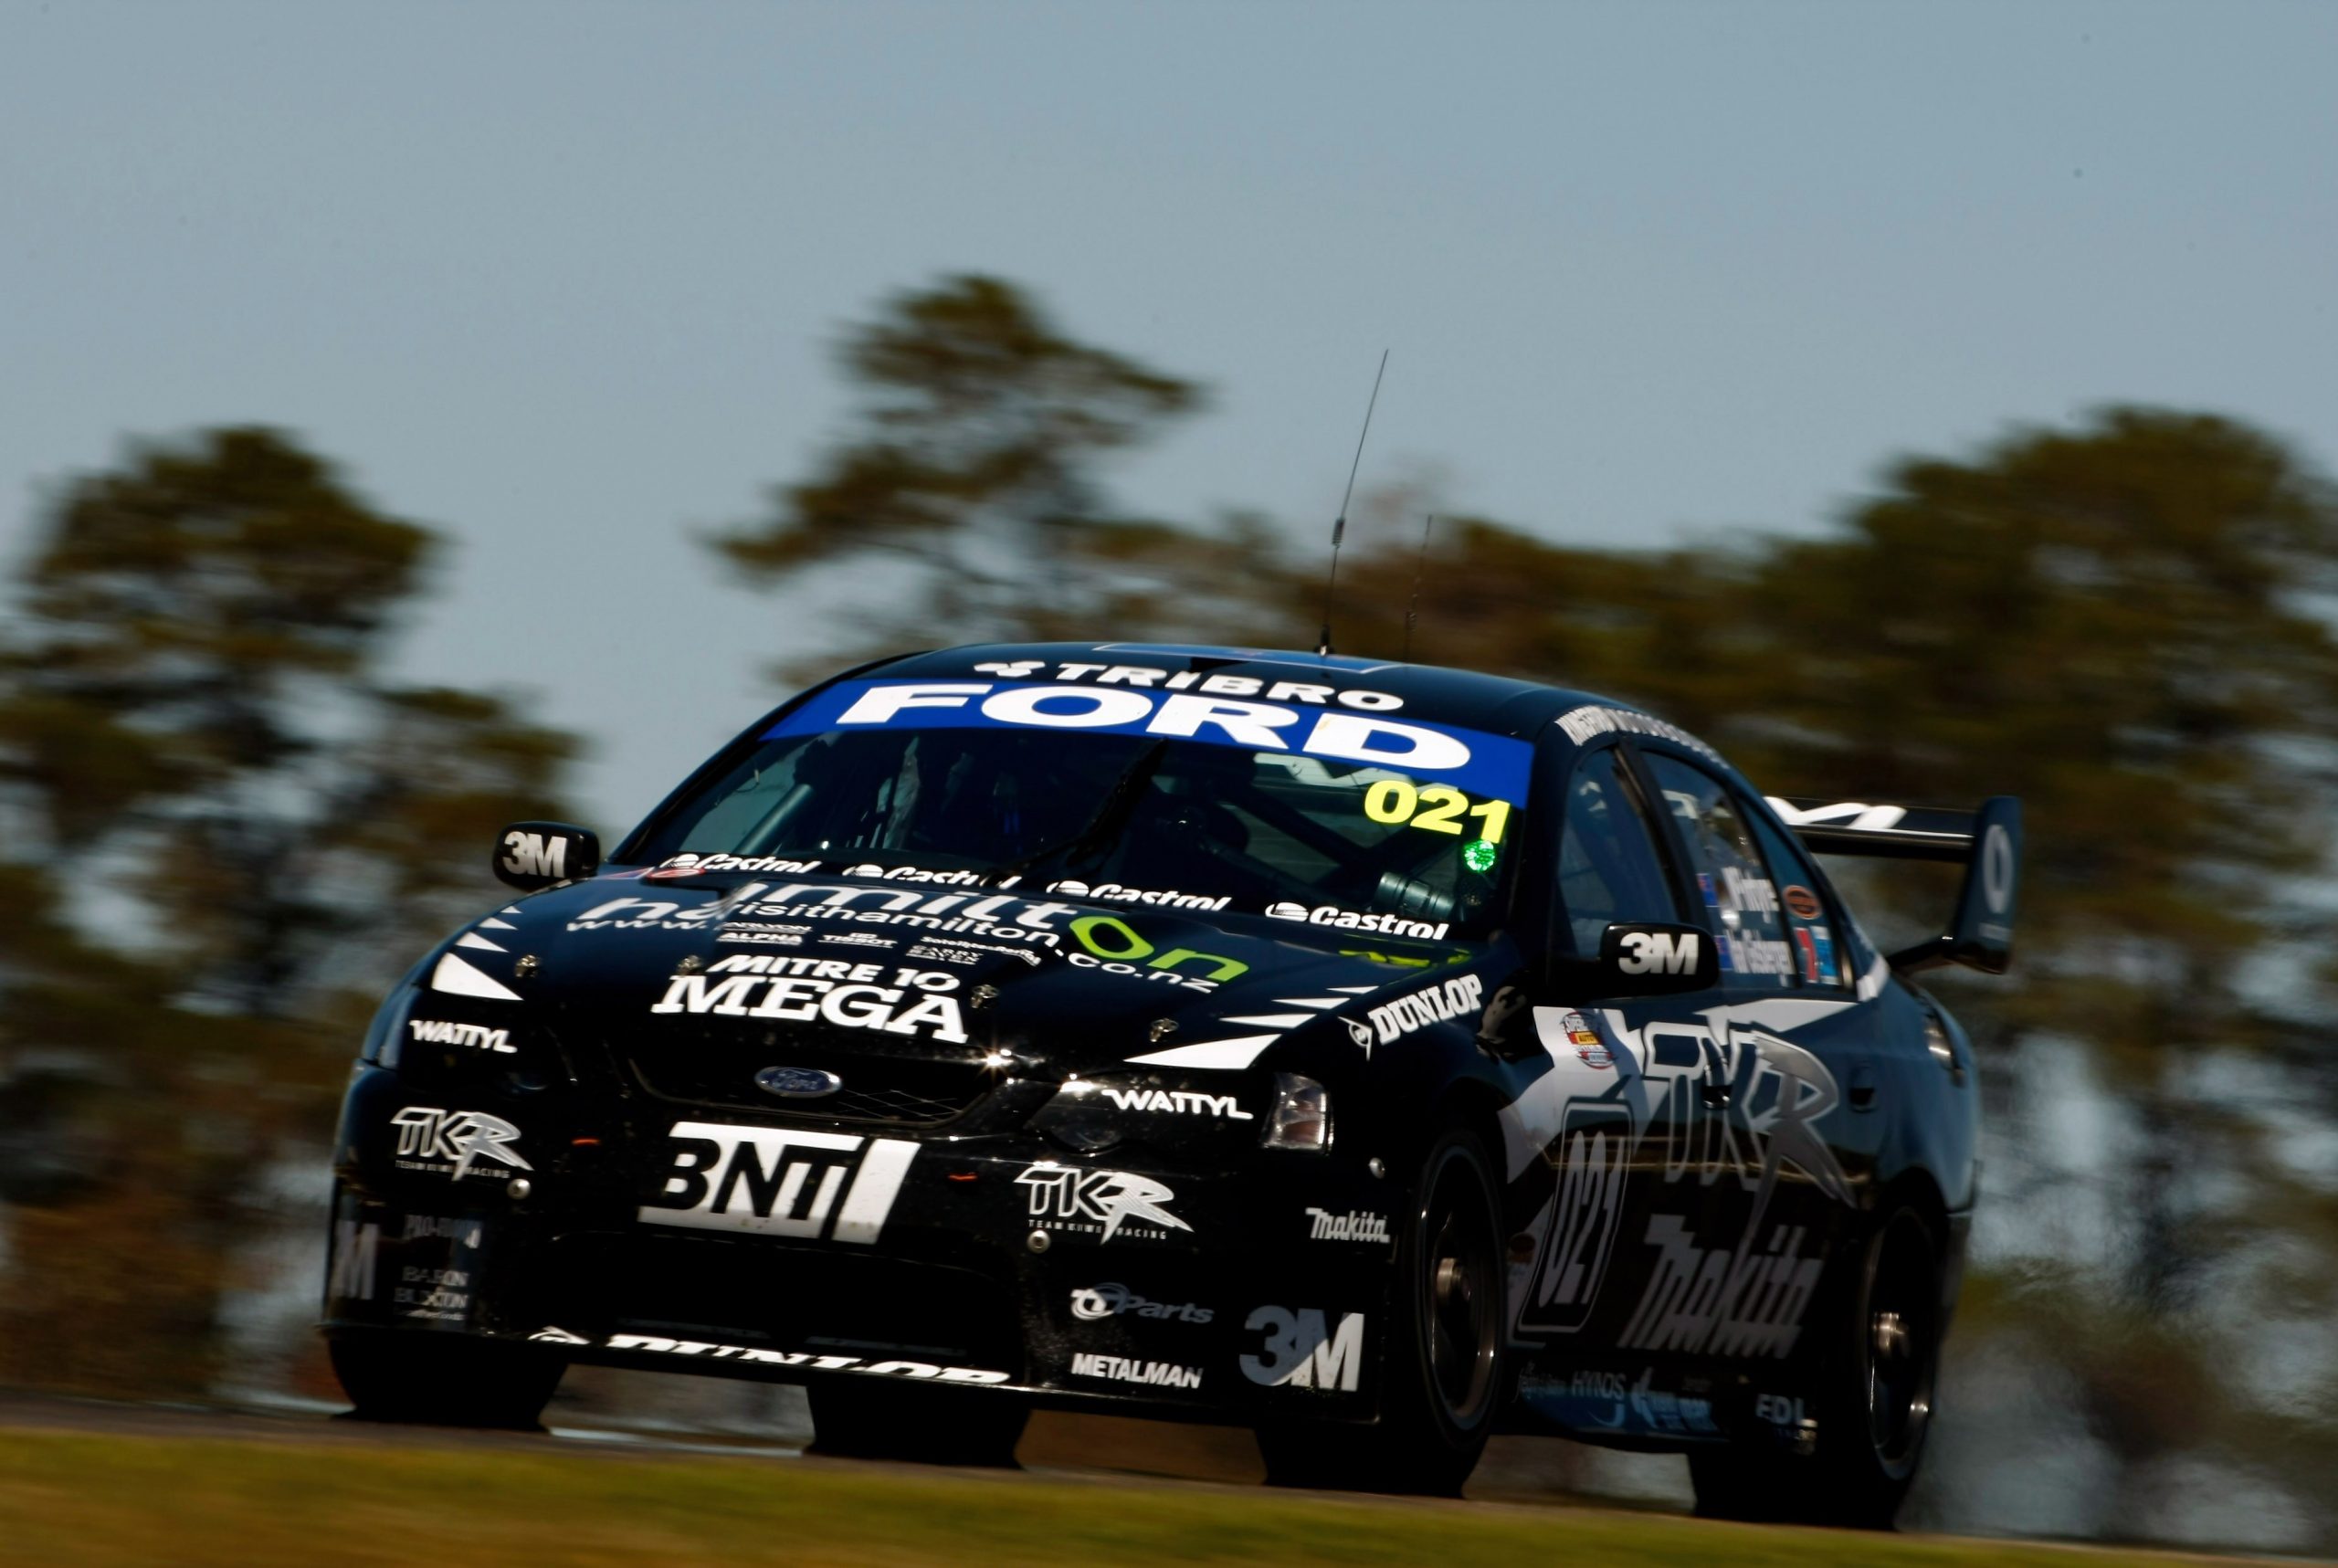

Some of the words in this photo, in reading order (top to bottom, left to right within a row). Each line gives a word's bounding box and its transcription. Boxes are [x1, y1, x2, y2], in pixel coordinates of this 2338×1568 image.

[1057, 662, 1405, 711] TRIBRO
[835, 682, 1472, 771] FORD
[1364, 779, 1511, 845] 021
[503, 830, 565, 879] 3M
[697, 853, 822, 875] Castrol
[882, 865, 1023, 890] Castrl
[1089, 882, 1231, 913] Castrol
[1309, 904, 1449, 942] Castrol
[706, 953, 880, 983] MITRE
[894, 966, 962, 993] 10
[1617, 931, 1699, 976] 3M
[650, 974, 969, 1044] MEGA
[1370, 973, 1483, 1046] DUNLOP
[409, 1018, 518, 1055] WATTYL
[1101, 1089, 1254, 1121] WATTYL
[389, 1105, 536, 1182] TKR
[1012, 1167, 1197, 1247] TKR
[1539, 1129, 1626, 1310] 021
[1069, 1352, 1206, 1390] METALMAN
[1239, 1305, 1364, 1393] 3M
